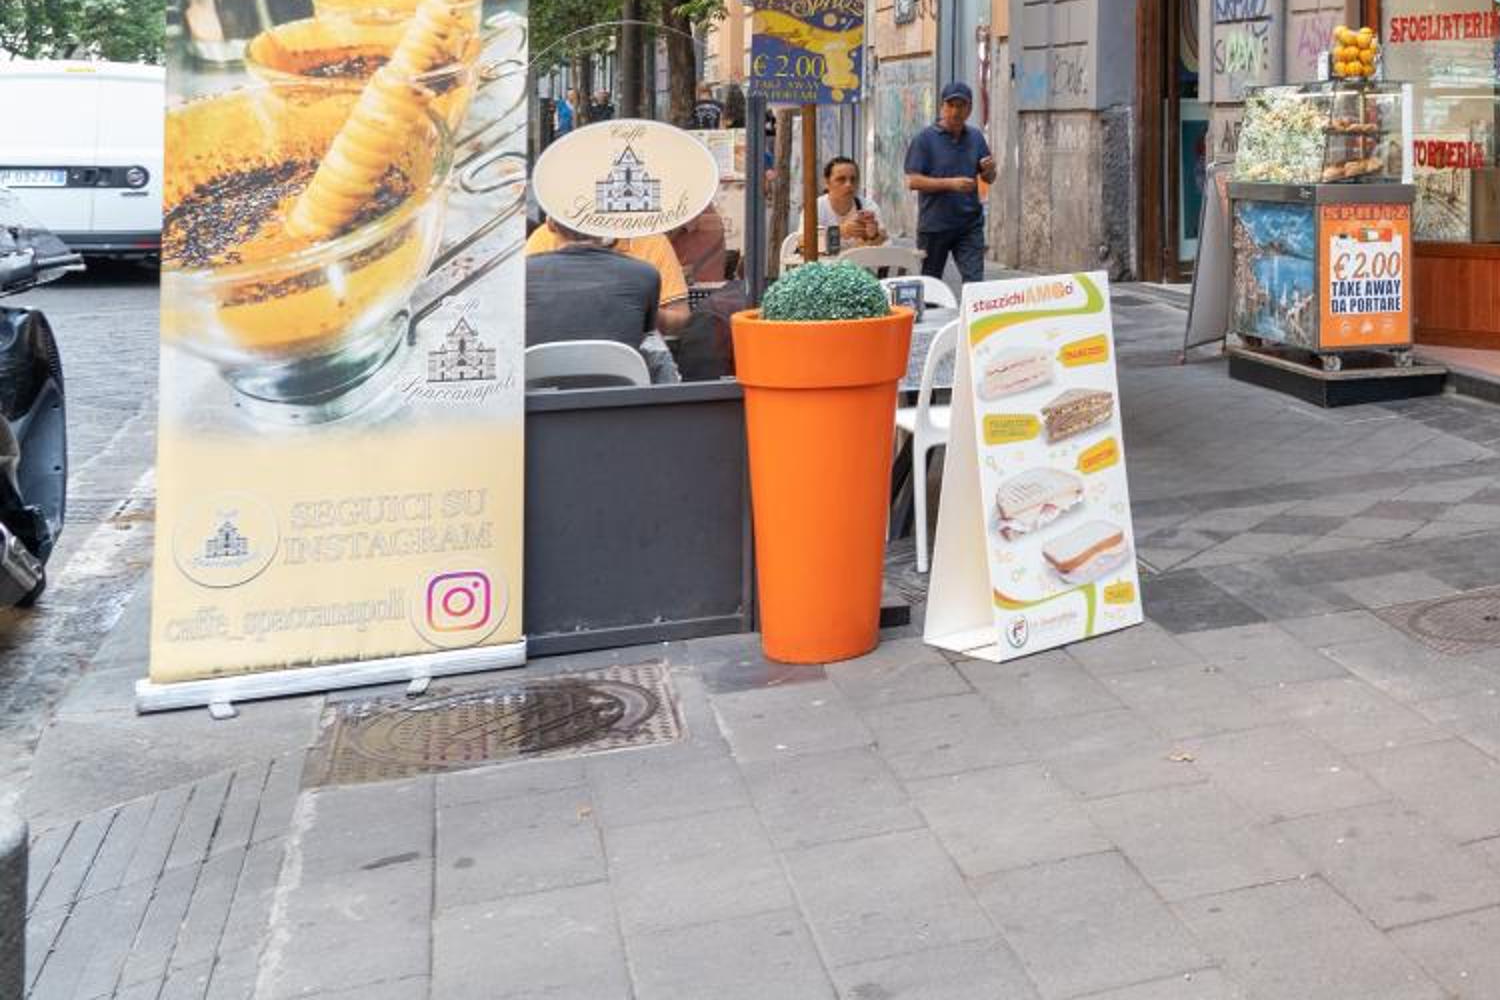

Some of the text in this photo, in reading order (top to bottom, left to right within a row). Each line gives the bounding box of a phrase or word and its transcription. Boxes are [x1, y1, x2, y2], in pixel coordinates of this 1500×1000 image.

[753, 55, 826, 79] € 2.00
[1333, 251, 1401, 281] € 2.00
[1331, 279, 1401, 297] TAKE AWAY
[1331, 296, 1401, 313] DA PORTARE
[290, 487, 490, 528] SEGUICI SU
[283, 522, 494, 566] INSTAGRAM
